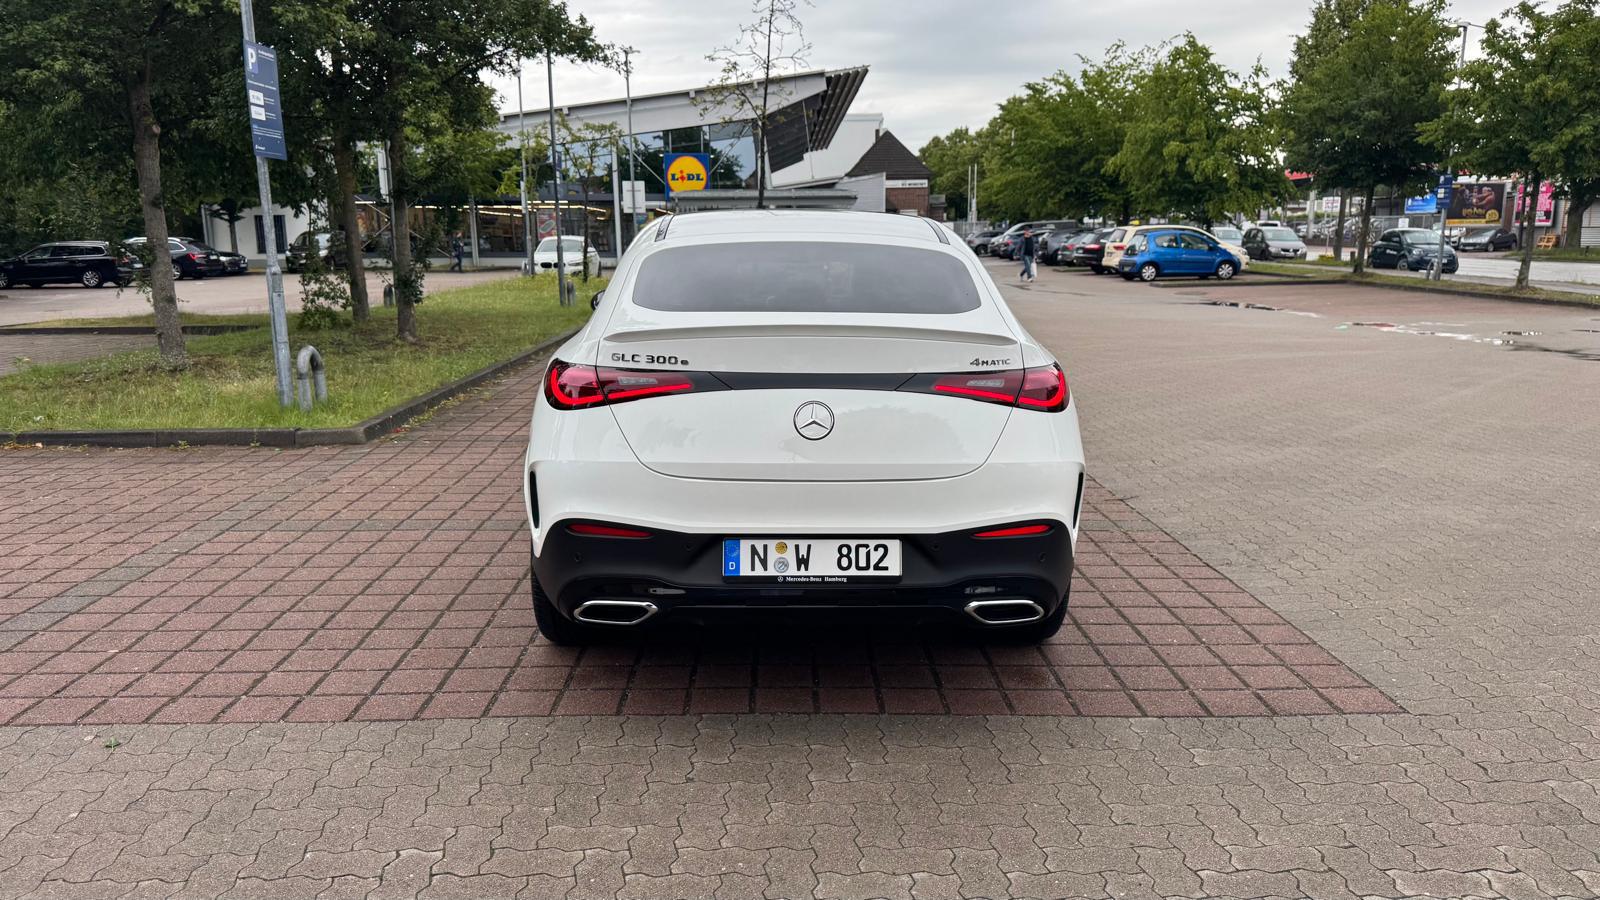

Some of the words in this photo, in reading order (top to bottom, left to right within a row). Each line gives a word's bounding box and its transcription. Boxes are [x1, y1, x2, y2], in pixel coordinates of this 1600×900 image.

[248, 47, 256, 69] P
[611, 352, 641, 363] GLC
[969, 357, 1011, 367] 4MATIC
[728, 561, 736, 570] D
[750, 543, 768, 572] N
[794, 543, 812, 572] W
[836, 543, 889, 572] 802
